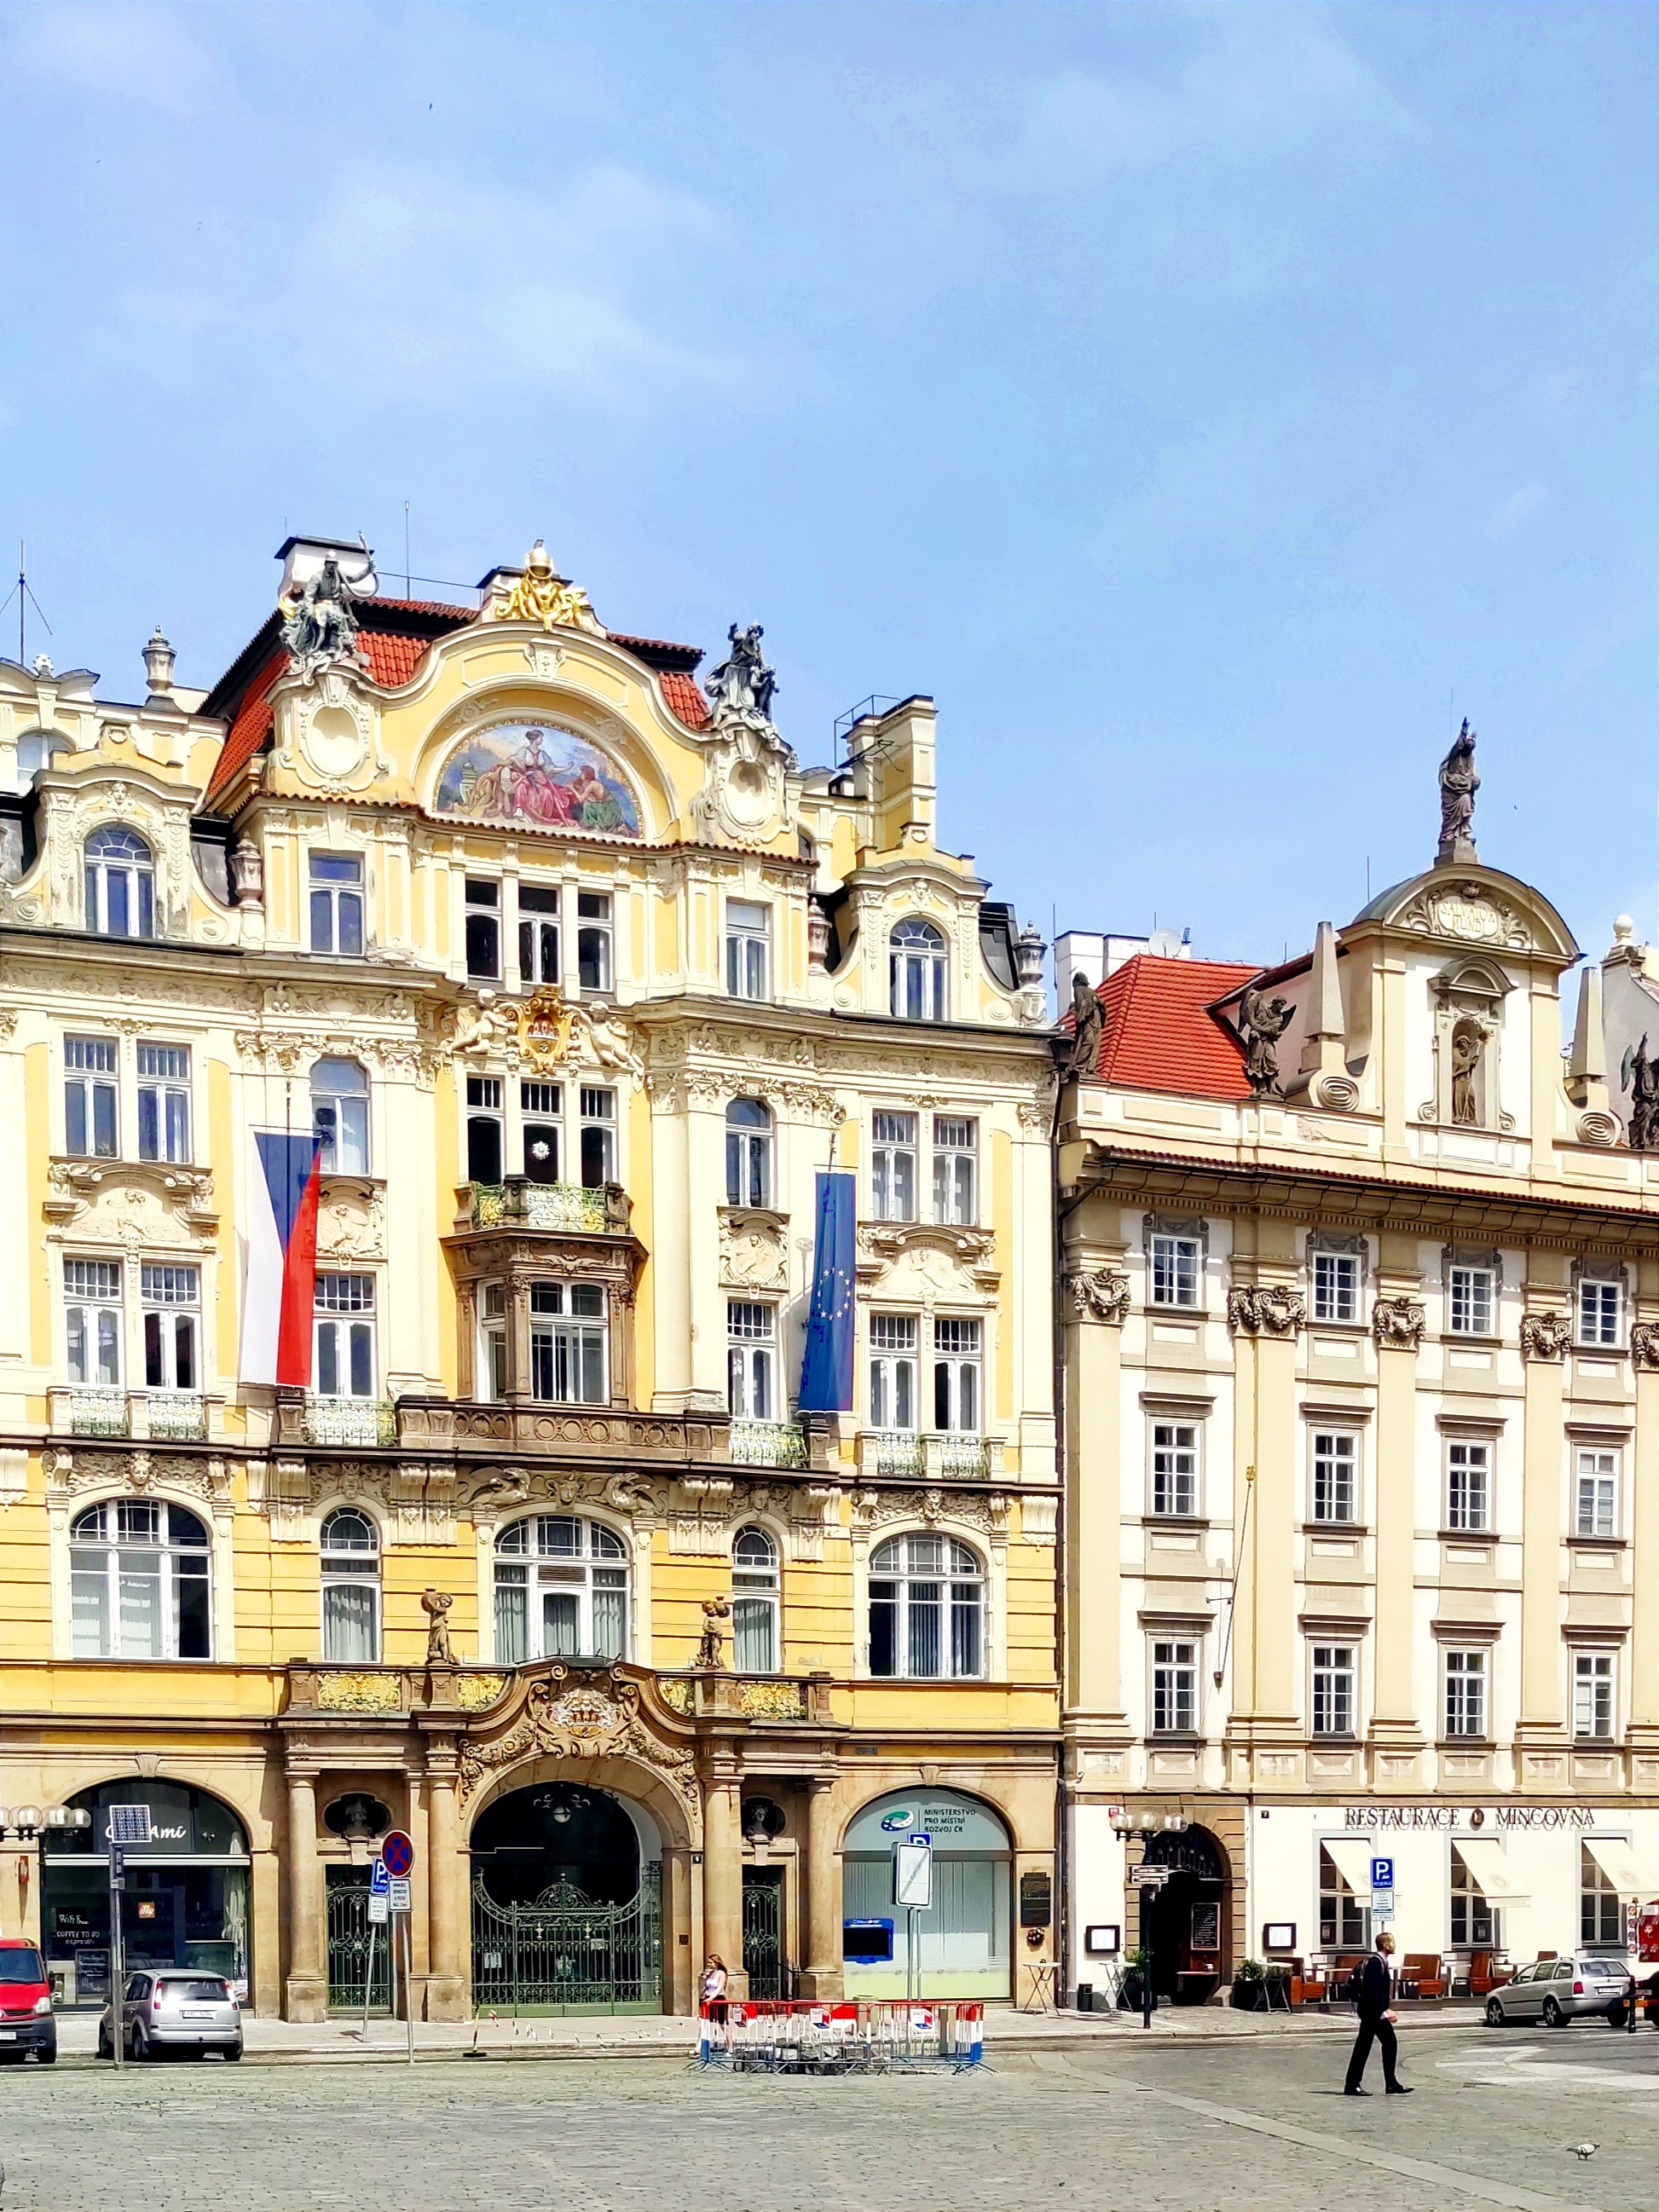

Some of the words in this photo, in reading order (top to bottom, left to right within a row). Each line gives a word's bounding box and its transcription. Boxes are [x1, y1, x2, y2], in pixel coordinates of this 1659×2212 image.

[1440, 902, 1495, 923] SALVATOR
[1345, 1807, 1460, 1826] RESTAURACE
[1497, 1807, 1595, 1826] MINCOVNA
[376, 1861, 387, 1883] P
[1376, 1861, 1390, 1880] P
[139, 1904, 154, 1915] illy
